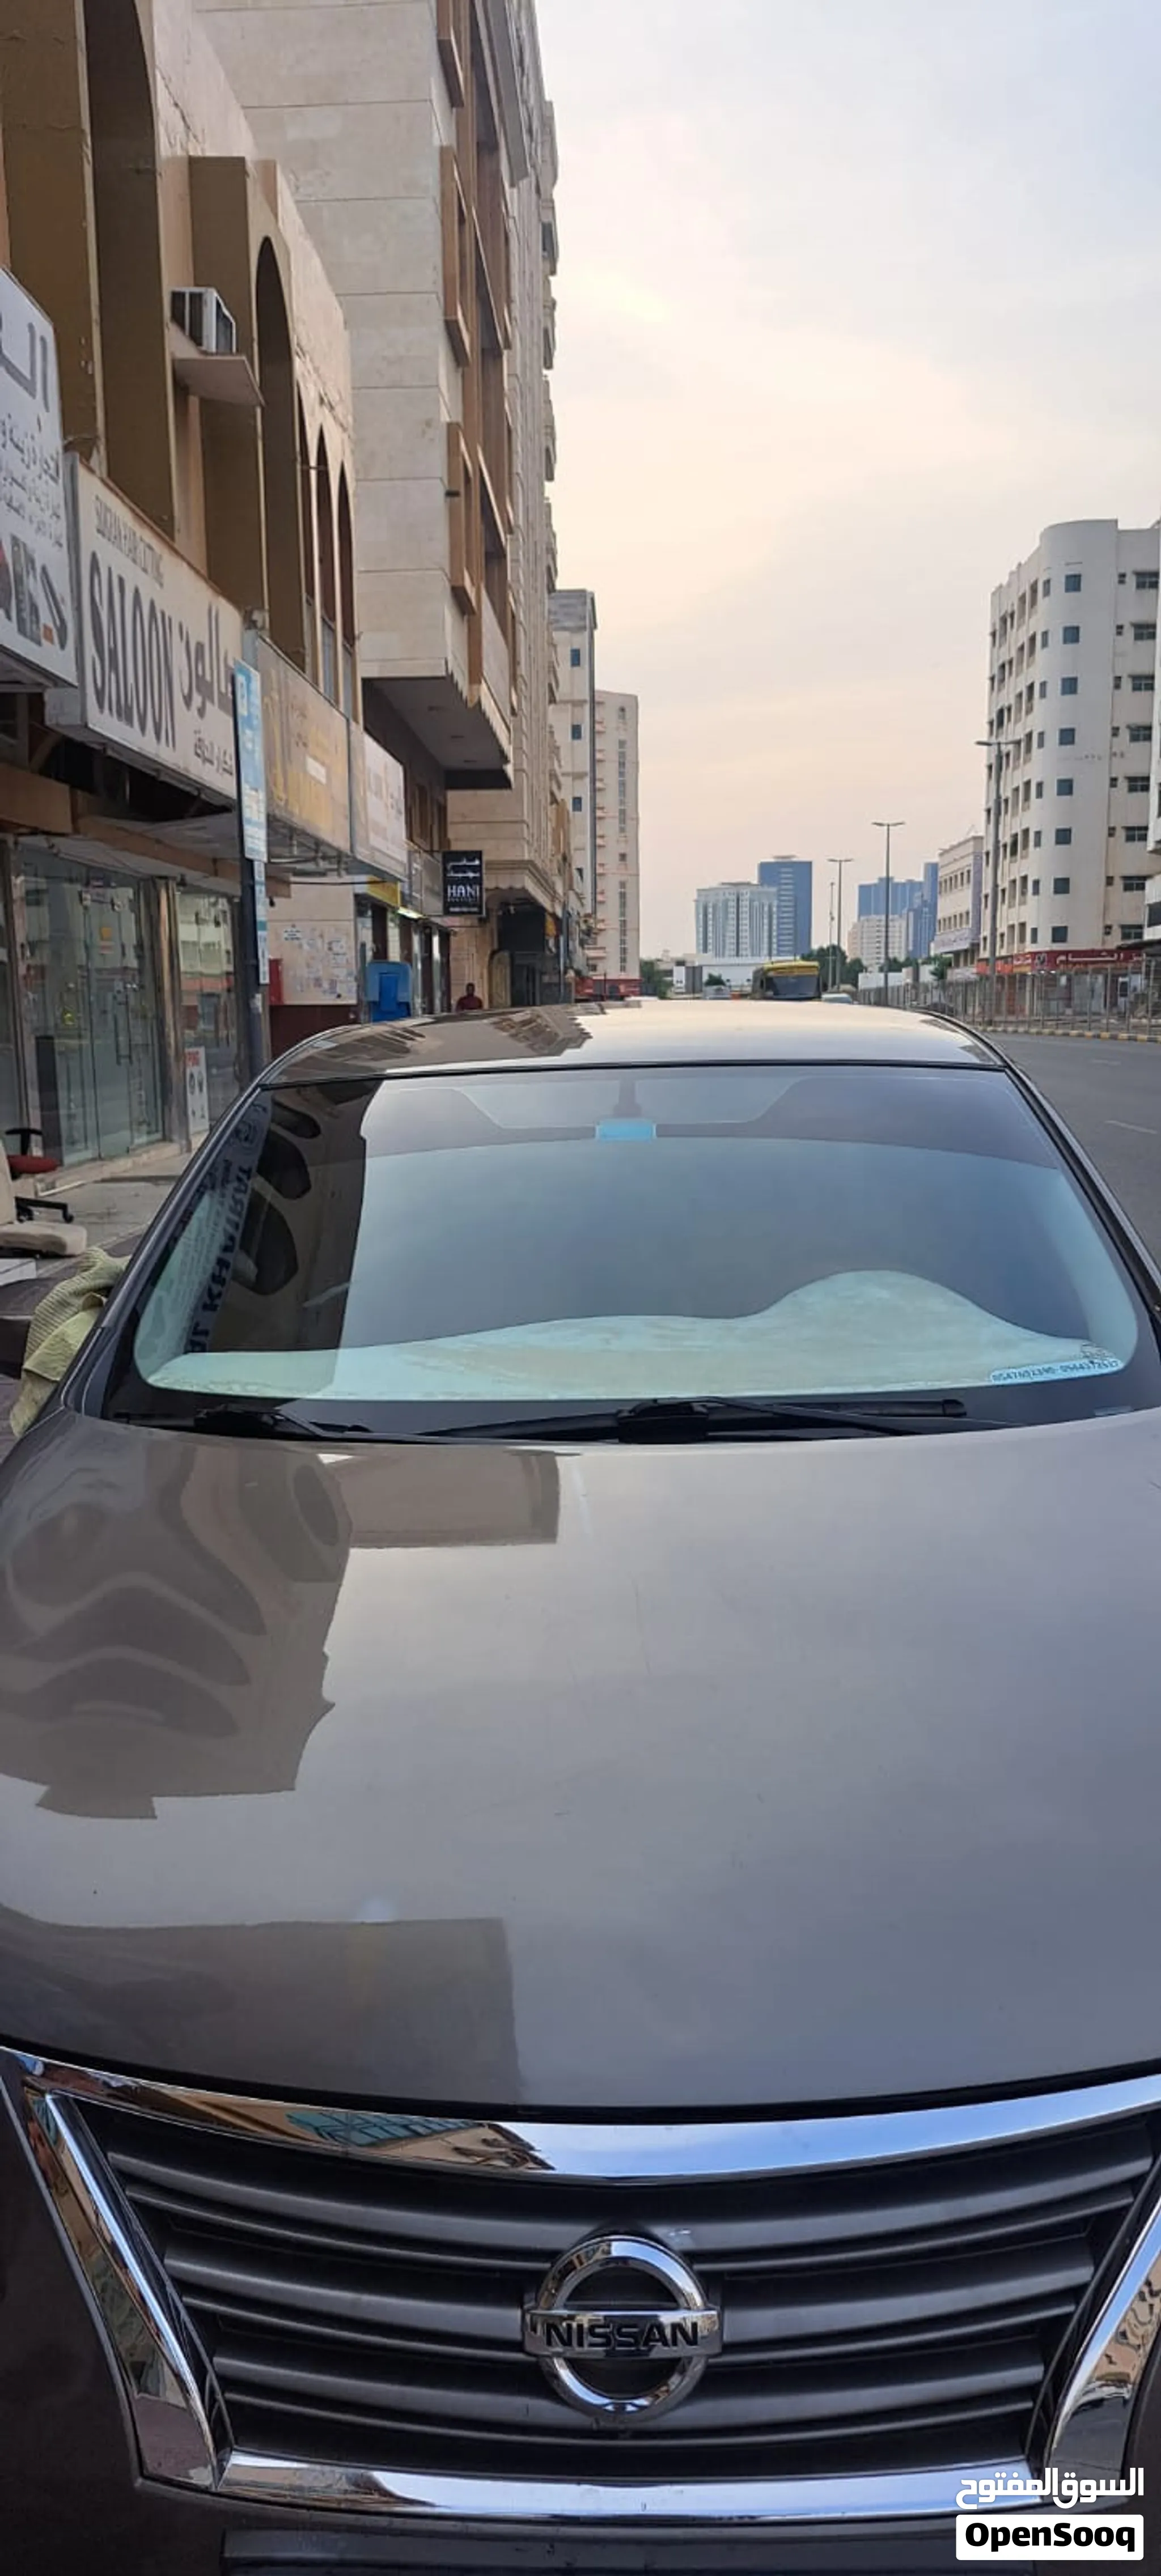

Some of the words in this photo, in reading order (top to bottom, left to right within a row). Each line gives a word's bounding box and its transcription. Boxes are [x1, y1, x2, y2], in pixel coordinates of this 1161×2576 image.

[90, 550, 176, 752] SALOON
[447, 885, 479, 897] HANI
[545, 2322, 698, 2348] NISSAN
